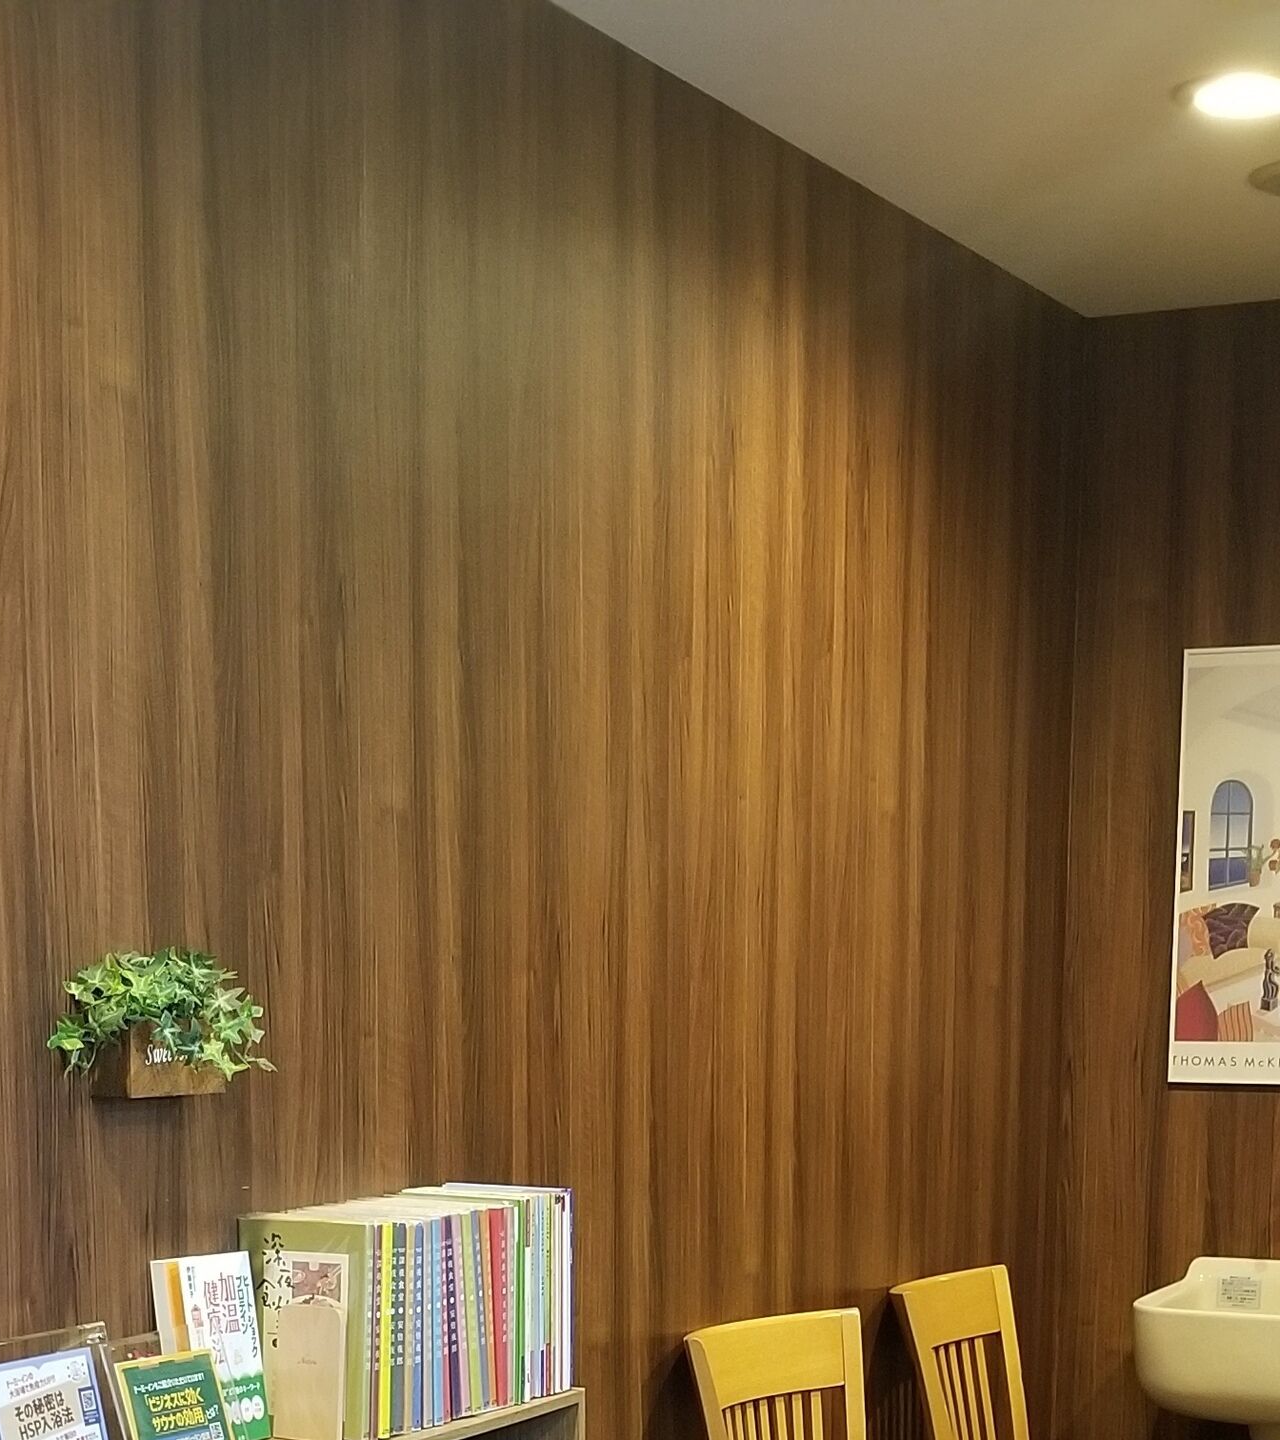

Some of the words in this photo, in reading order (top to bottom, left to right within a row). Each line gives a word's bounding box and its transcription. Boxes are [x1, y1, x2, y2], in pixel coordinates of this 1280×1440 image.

[1172, 1055, 1237, 1067] THOMAS
[218, 1272, 241, 1334] 加温
[236, 1275, 249, 1334] プロテイン
[242, 1275, 258, 1358] ヒートショック
[15, 1391, 64, 1422] その秘密は
